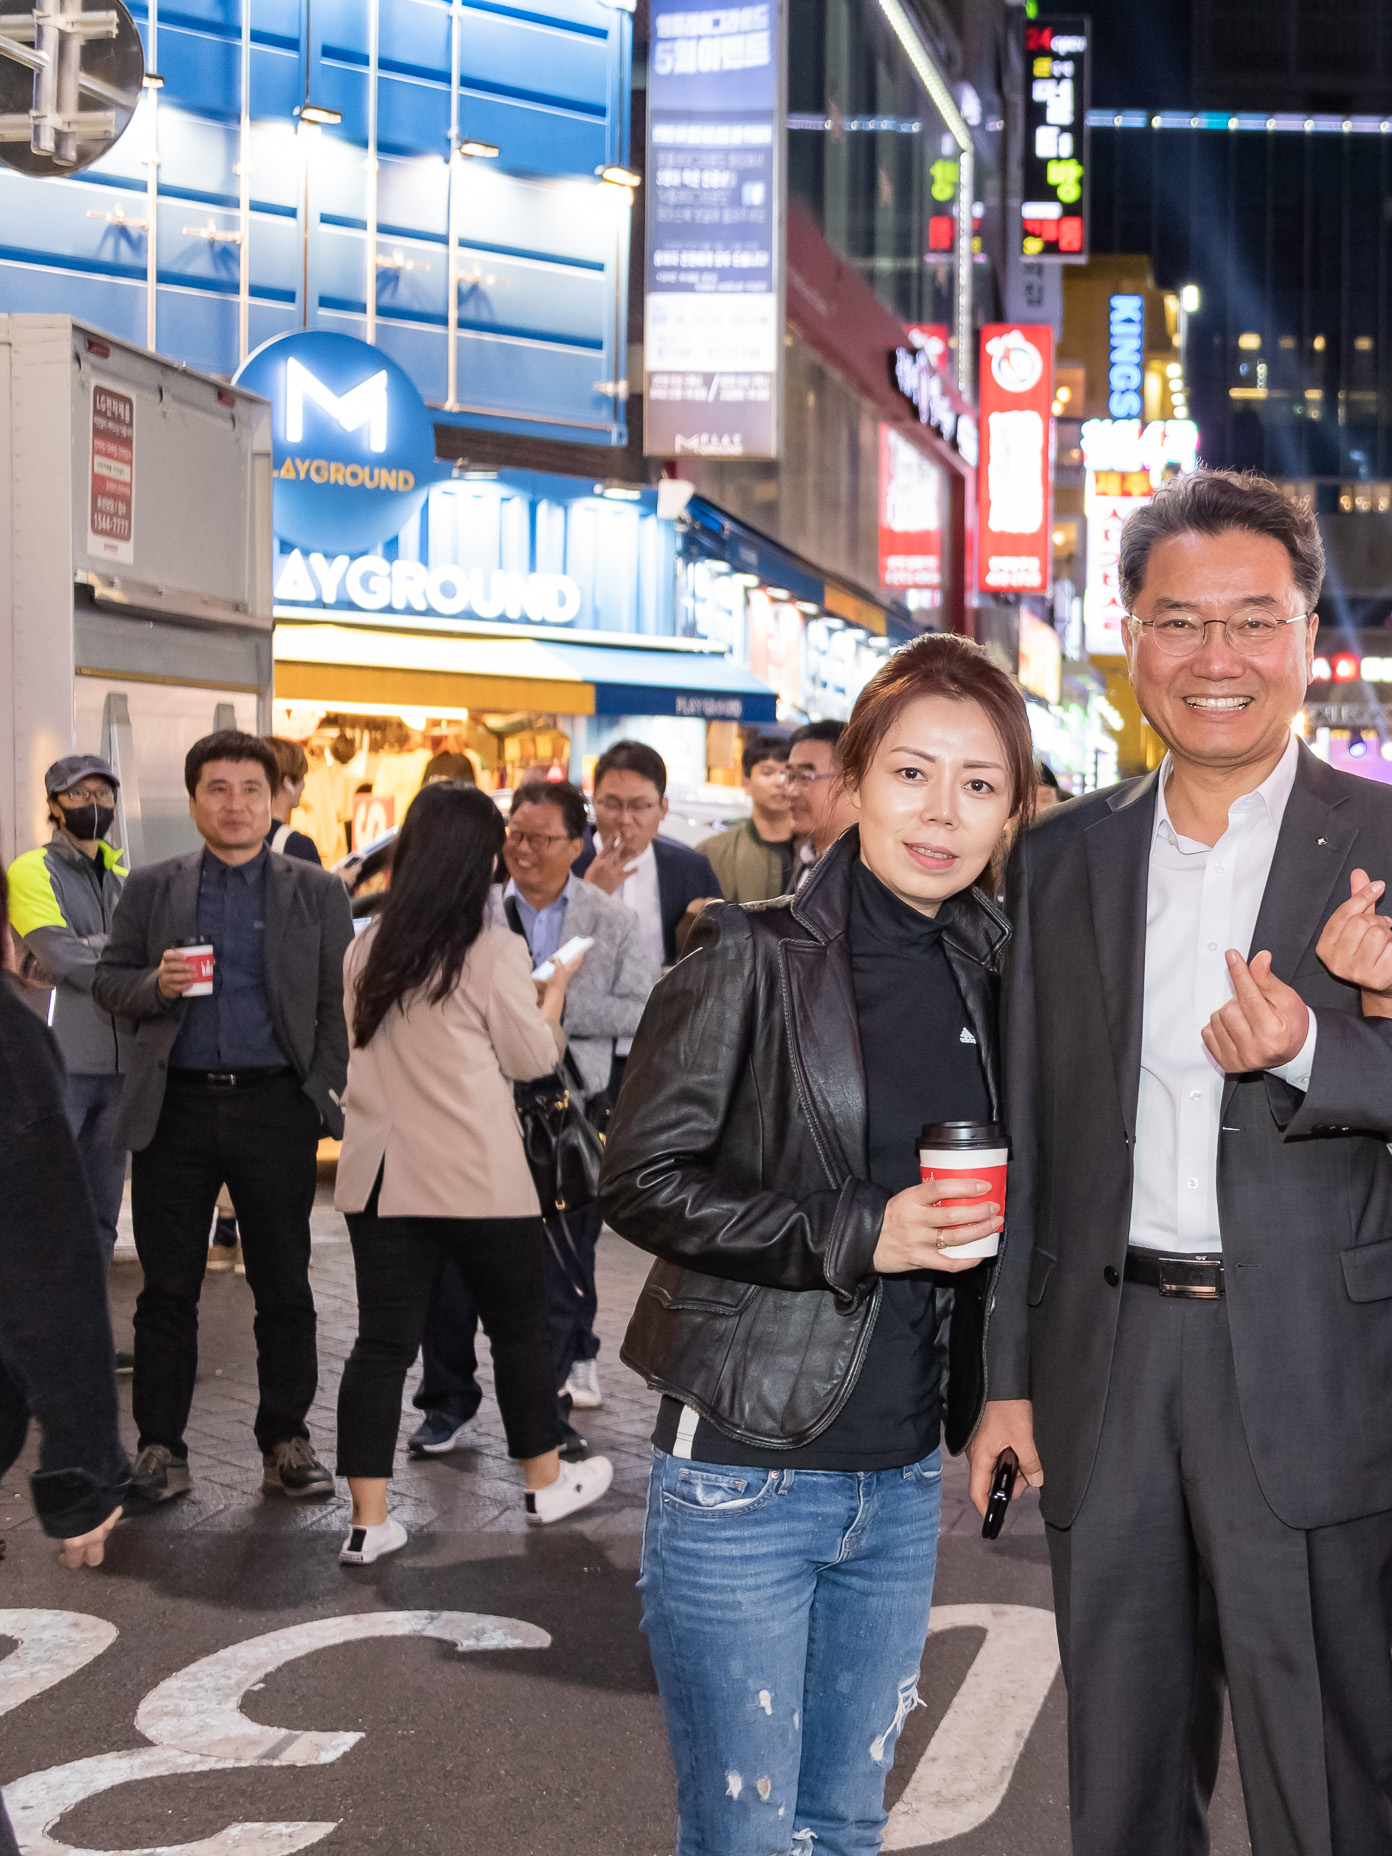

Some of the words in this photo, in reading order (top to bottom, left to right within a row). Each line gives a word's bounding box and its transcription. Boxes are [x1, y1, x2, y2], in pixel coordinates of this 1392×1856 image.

[1109, 294, 1144, 419] KINGS
[286, 356, 388, 452] M
[273, 457, 415, 491] AYGROUND
[273, 548, 581, 623] AYGROUND
